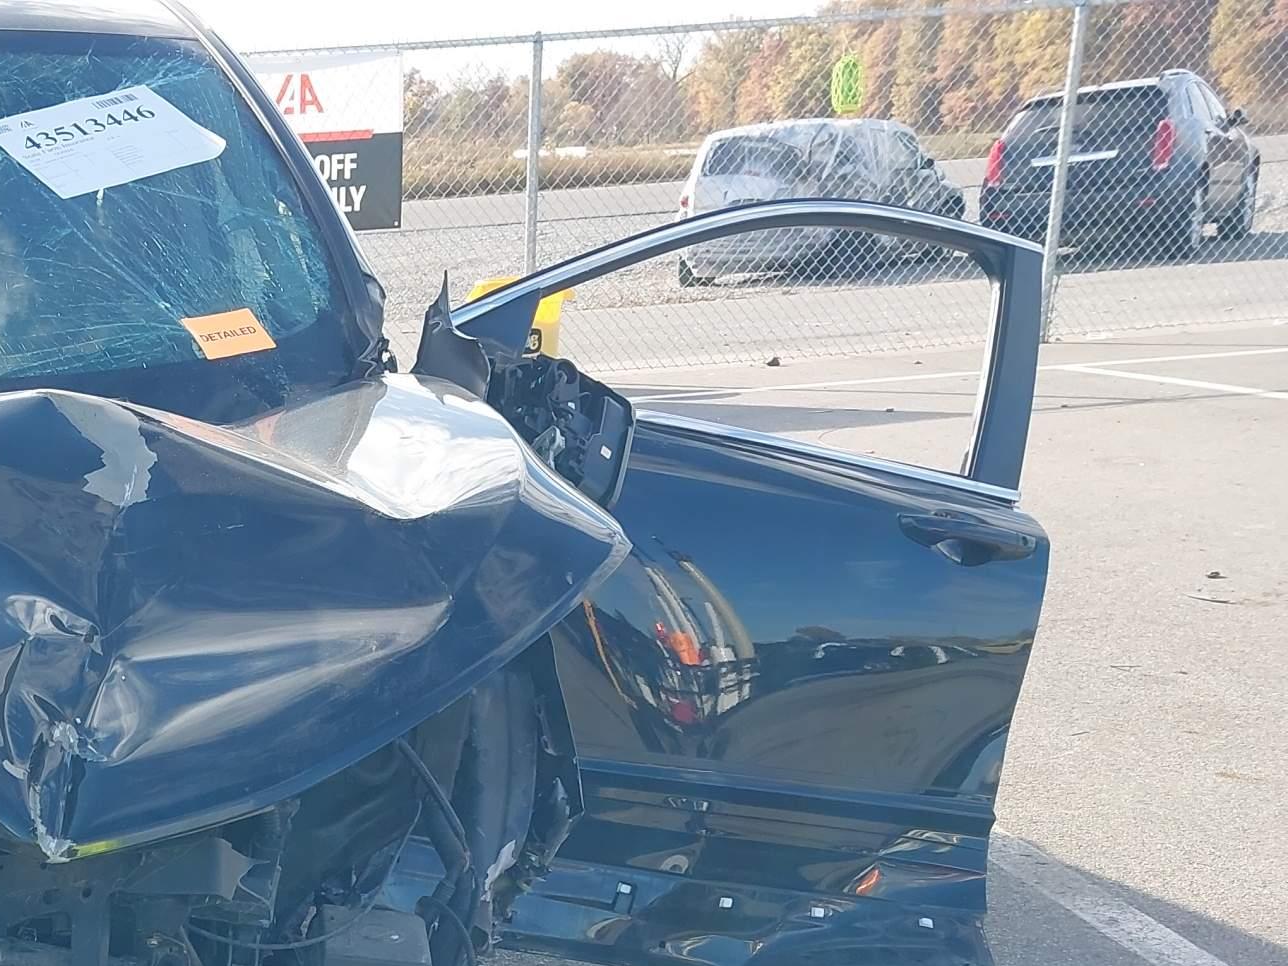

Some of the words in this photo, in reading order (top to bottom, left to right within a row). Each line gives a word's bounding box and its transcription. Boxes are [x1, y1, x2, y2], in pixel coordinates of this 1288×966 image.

[25, 105, 155, 149] 43513446
[314, 152, 358, 181] OFF
[199, 326, 257, 343] DETAILED
